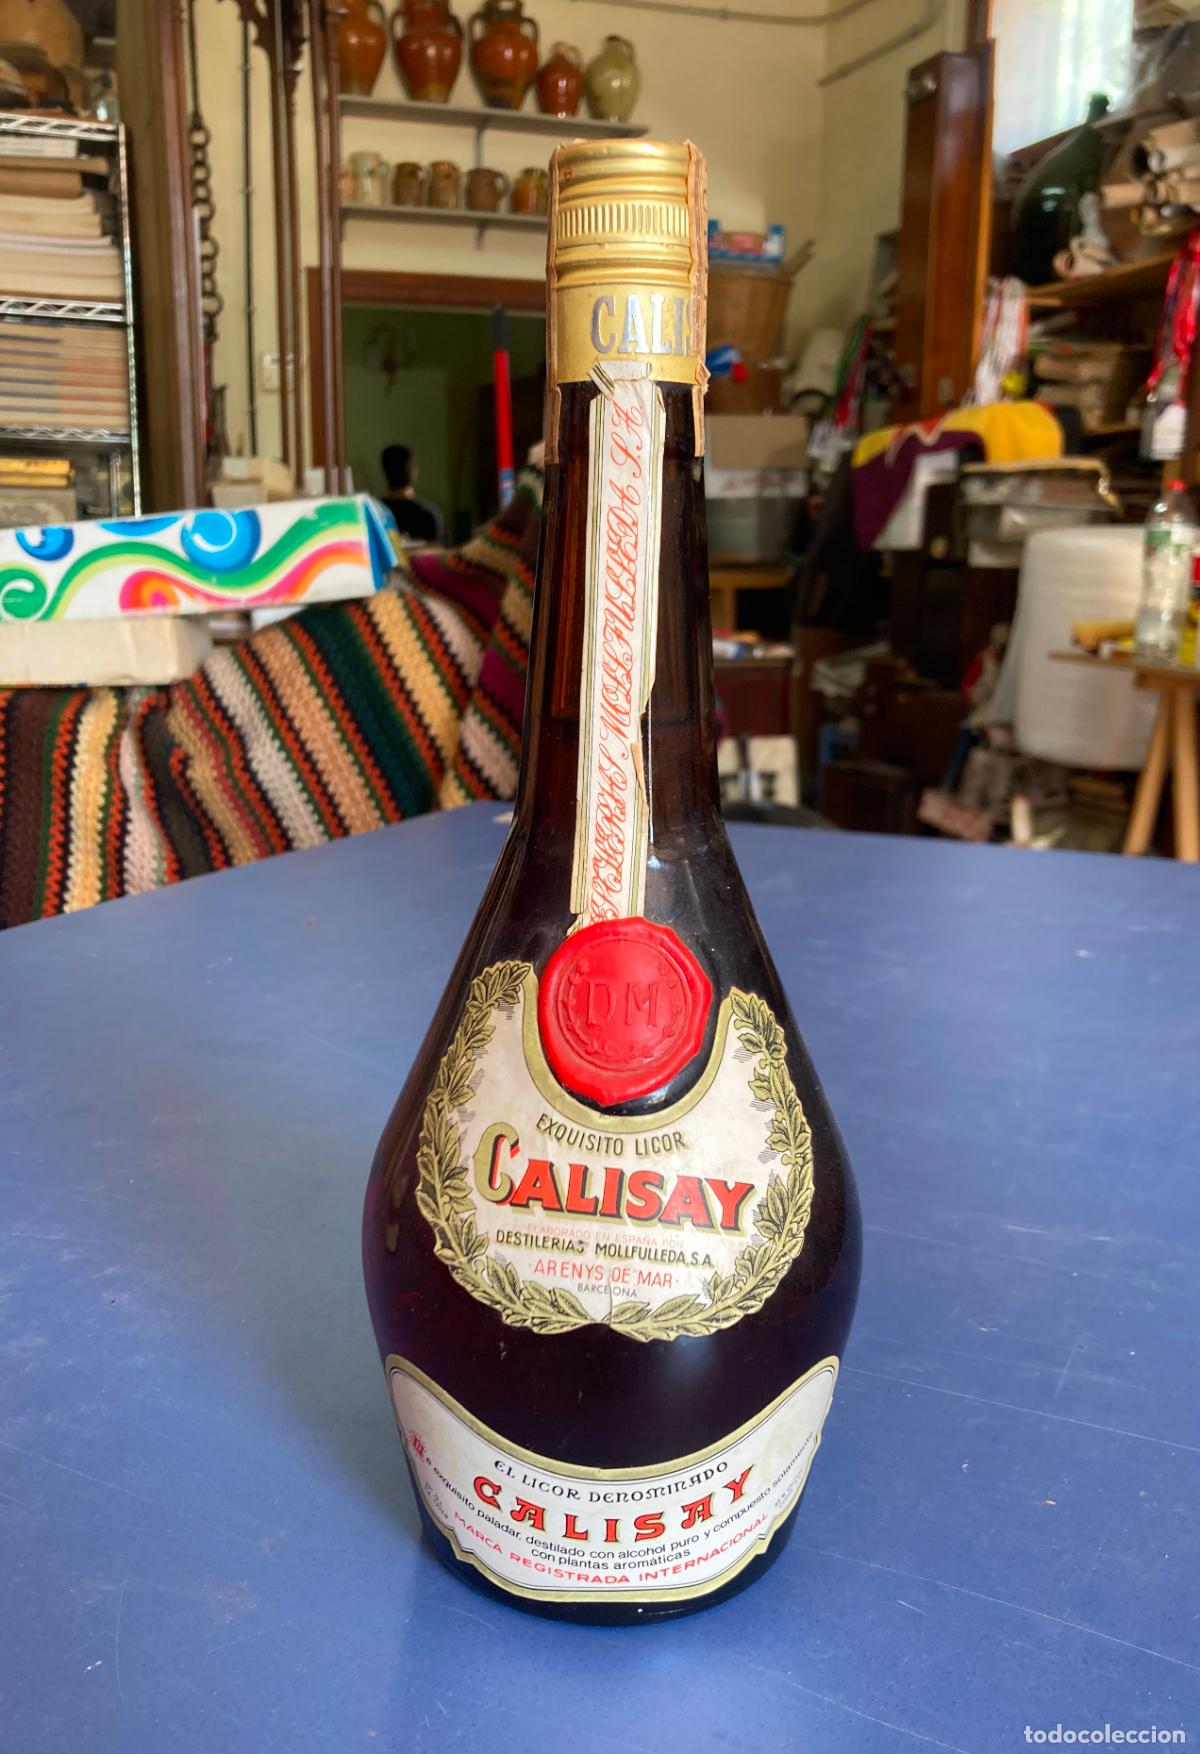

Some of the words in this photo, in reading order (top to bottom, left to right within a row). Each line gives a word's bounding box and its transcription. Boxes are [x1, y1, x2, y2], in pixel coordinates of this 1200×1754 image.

[536, 1113, 624, 1157] EXQUISITO
[635, 1131, 687, 1157] LICOR
[473, 1122, 756, 1235] CALISAY
[495, 1229, 585, 1254] DESTILERIAS
[527, 1223, 591, 1239] ELABORADO
[595, 1231, 610, 1242] EN
[614, 1232, 657, 1246] ESPAÑA
[534, 1259, 604, 1281] ARENYS
[611, 1267, 631, 1284] DE
[637, 1270, 673, 1288] MAR
[577, 1283, 638, 1298] BARCEONA
[494, 1460, 515, 1478] EL
[521, 1474, 581, 1501] LICOR
[433, 1467, 476, 1511] exquisito
[525, 1535, 586, 1559] destilado
[589, 1549, 615, 1559] con
[619, 1544, 666, 1560] alcohol
[671, 1533, 700, 1552] puro
[703, 1529, 711, 1540] y
[713, 1487, 771, 1533] compuesto
[473, 1463, 756, 1543] CALISAY
[453, 1511, 503, 1555] MARCA
[510, 1552, 630, 1585] REGISTRADA
[639, 1513, 769, 1581] INTERNACIONAL
[531, 1549, 555, 1563] con
[559, 1555, 609, 1571] plantas
[613, 1549, 691, 1571] aromáticas
